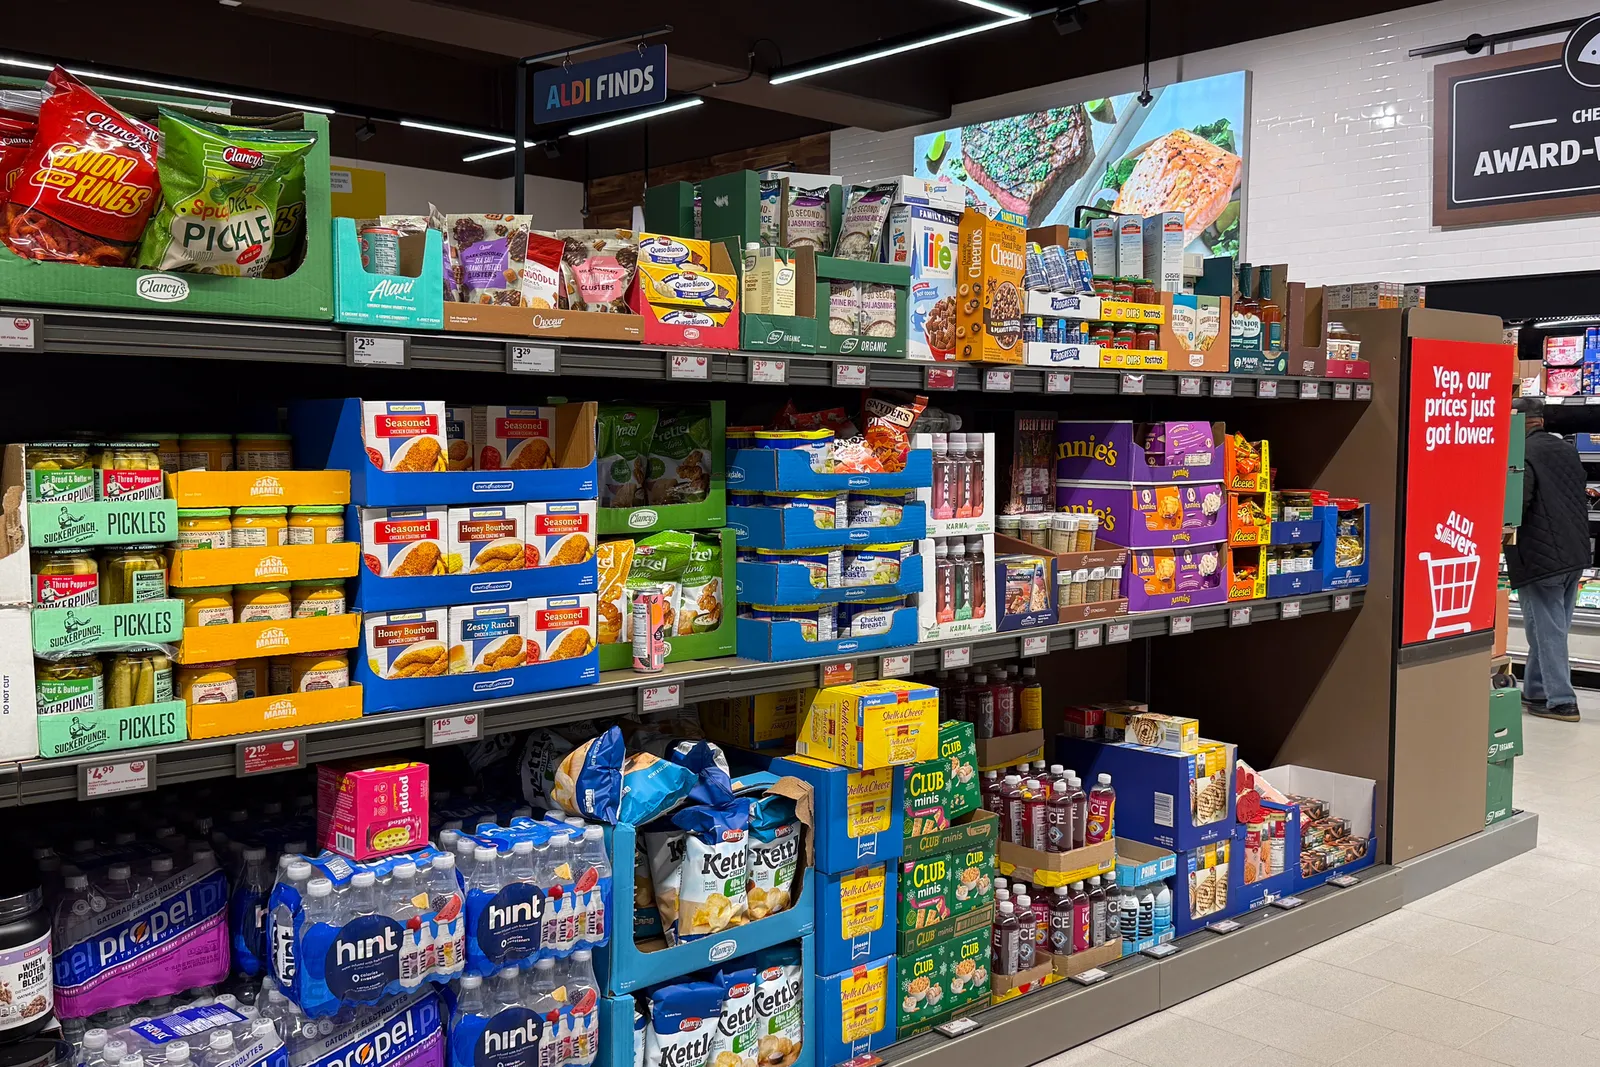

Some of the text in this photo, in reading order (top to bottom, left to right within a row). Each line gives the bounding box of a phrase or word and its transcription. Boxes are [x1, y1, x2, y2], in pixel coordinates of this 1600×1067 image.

[547, 65, 653, 110] ALDI FINDS
[86, 111, 153, 154] Clancy's
[51, 144, 136, 176] ONION
[223, 147, 265, 168] Clancy's
[37, 171, 73, 186] HOT
[69, 182, 151, 214] RINGS
[795, 209, 820, 219] SECOND
[920, 210, 941, 222] FAMILY
[1001, 211, 1024, 225] FAMILY SIZE
[183, 215, 271, 252] PICKLE
[923, 232, 952, 271] life
[969, 228, 983, 279] Cheerios
[990, 243, 1024, 271] Cheerios
[138, 277, 186, 298] Clancy's
[368, 279, 414, 306] Alani
[1053, 297, 1080, 309] PROGRESSO
[1126, 306, 1140, 318] DIPS
[533, 315, 565, 328] Choceur
[861, 341, 887, 352] ORGANIC
[1052, 348, 1080, 360] PROGRESSO
[1126, 355, 1141, 366] DIPS
[1433, 365, 1491, 394] Yep, our
[865, 398, 912, 424] SNYDER'S
[1425, 396, 1495, 422] prices just
[386, 418, 431, 427] Seasoned
[504, 421, 542, 430] Seasoned
[616, 423, 640, 436] Pretzel
[1019, 418, 1054, 431] DESERT HEAT
[1426, 424, 1494, 451] got lower.
[117, 475, 132, 483] Three
[1172, 467, 1190, 478] Annie's
[256, 478, 279, 487] CASA
[1232, 476, 1256, 488] Reese's
[250, 486, 284, 496] MAMITA
[108, 511, 166, 535] PICKLES
[544, 517, 582, 527] Seasoned
[630, 512, 656, 524] Clancy's
[1447, 510, 1473, 538] ALDI
[44, 522, 95, 543] SUCKERPUNCH
[385, 523, 431, 534] Seasoned
[462, 523, 514, 533] Honey Bourbon
[946, 522, 968, 530] KARMA
[1172, 532, 1190, 542] Annie's
[1233, 531, 1256, 542] Reese's
[260, 559, 283, 568] CASA
[255, 566, 289, 577] MAMITA
[1171, 594, 1190, 605] Annie's
[1229, 587, 1251, 598] Reese's
[544, 610, 583, 621] Seasoned
[860, 614, 886, 624] Chicken
[114, 612, 172, 637] PICKLES
[378, 624, 435, 639] Honey Bourbon
[466, 620, 515, 632] Zesty Ranch
[860, 622, 882, 630] Breast
[950, 624, 971, 632] KARMA
[50, 625, 102, 648] SUCKERPUNCH
[260, 629, 284, 639] CASA
[256, 637, 290, 648] MAMITA
[838, 642, 858, 650] Brookdale
[3, 706, 10, 714] DO
[268, 702, 292, 711] CASA
[264, 708, 297, 720] MAMITA
[882, 711, 899, 722] Shells
[904, 708, 924, 718] Cheese
[120, 712, 175, 741] PICKLES
[54, 730, 106, 754] SUCKERPUNCH
[942, 742, 962, 758] CLUB
[910, 772, 944, 796] CLUB
[399, 775, 412, 814] poppi
[914, 792, 940, 807] minis
[722, 829, 745, 842] Clancy's
[920, 832, 963, 850] CLUB minis
[966, 851, 983, 866] CLUB
[729, 868, 745, 878] CHIPS
[914, 861, 945, 887] CLUB
[1141, 865, 1157, 878] PRIME
[862, 879, 883, 891] Cheese
[917, 883, 941, 898] minis
[97, 874, 187, 926] GATORADE ELECTROLYTES
[489, 895, 541, 930] hint
[99, 889, 193, 967] propel
[587, 911, 595, 934] hint
[1050, 917, 1070, 928] ICE
[558, 918, 566, 942] hint
[916, 925, 953, 946] CLUB minis
[108, 917, 194, 963] FITNESS WATER
[337, 926, 398, 966] hint
[711, 944, 733, 959] Clancy's
[961, 942, 979, 958] CLUB
[22, 958, 42, 972] WHEY
[401, 955, 409, 979] hint
[914, 959, 933, 977] CLUB
[18, 964, 46, 981] PROTEIN
[762, 967, 784, 980] Clancy's
[22, 975, 44, 988] BLEND
[862, 980, 883, 993] Cheese
[729, 983, 751, 997] Clancy's
[773, 1002, 791, 1015] CHIPS
[325, 995, 407, 1047] GATORADE ELECTROLYTES
[678, 1017, 702, 1032] Clancy's
[484, 1019, 538, 1051] hint
[384, 1038, 414, 1059] WATER
